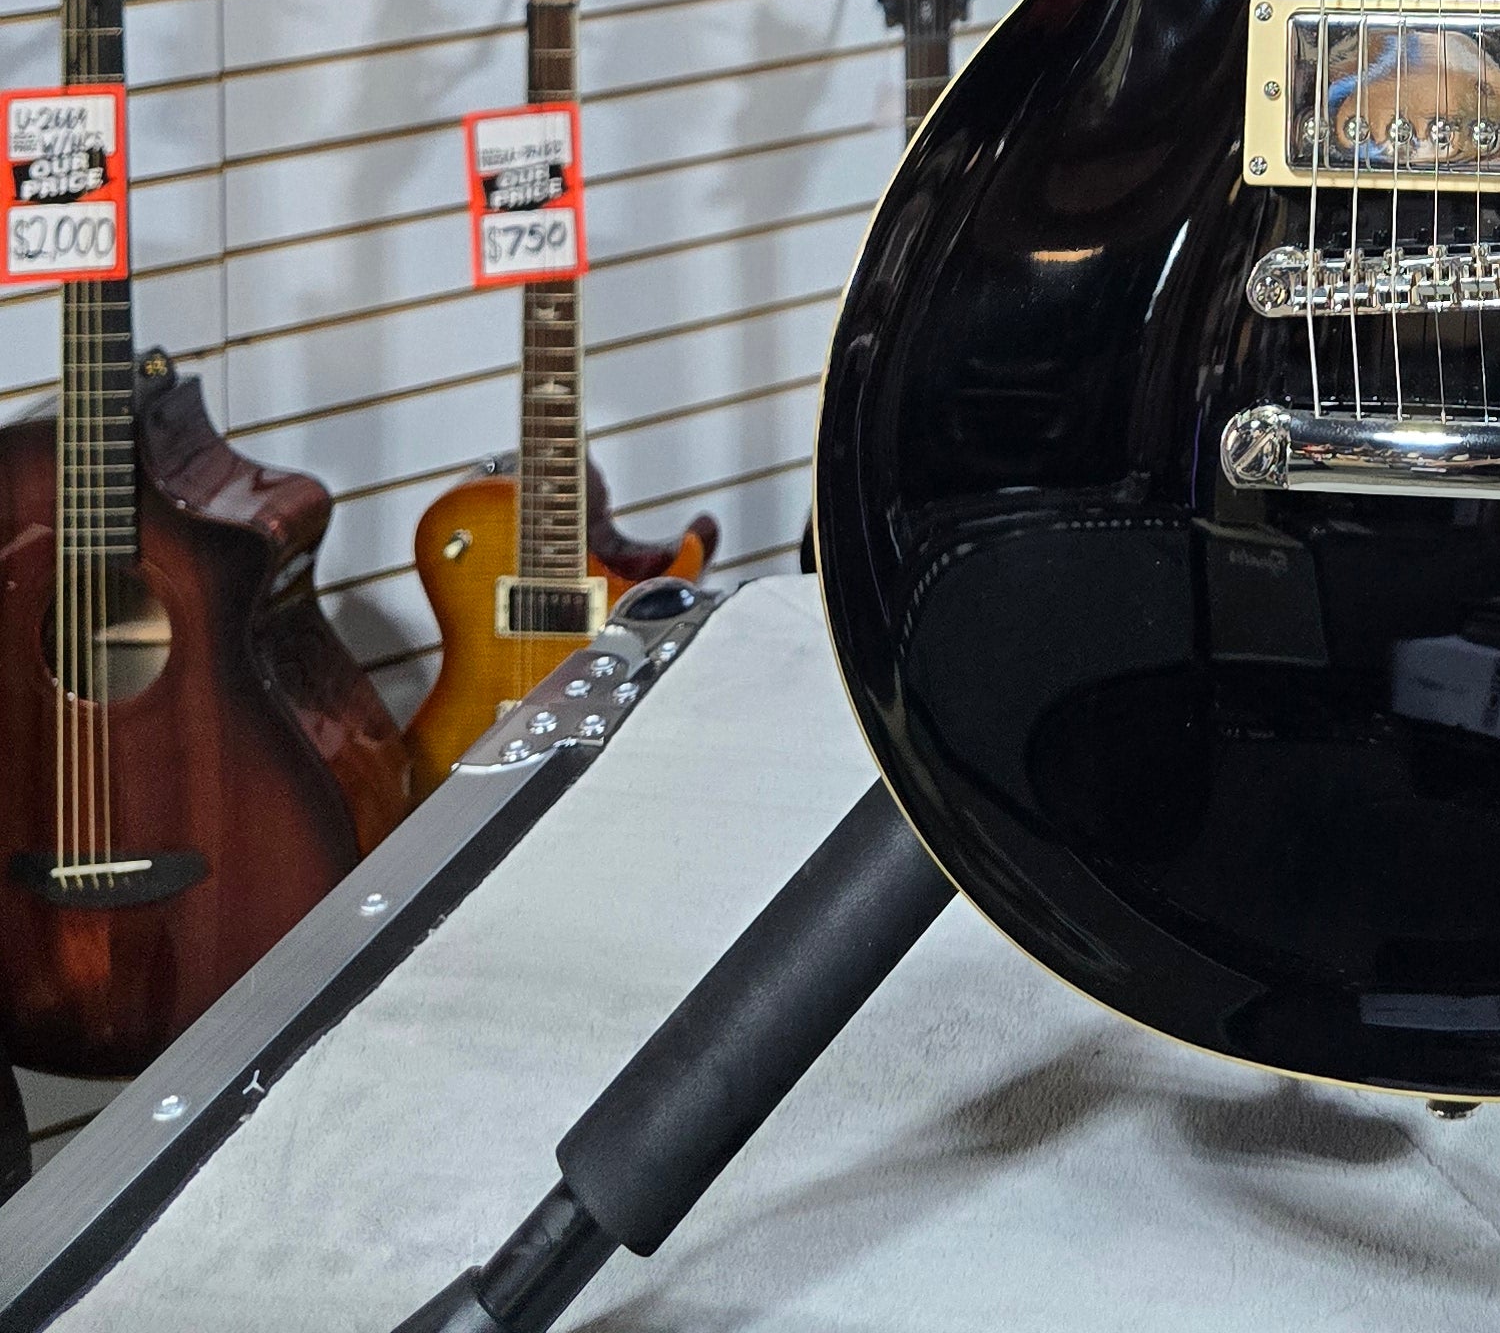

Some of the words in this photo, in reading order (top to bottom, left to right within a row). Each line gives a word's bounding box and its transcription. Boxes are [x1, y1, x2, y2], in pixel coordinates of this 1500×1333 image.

[20, 167, 104, 202] PRICE
[28, 152, 90, 180] OUR
[13, 215, 116, 262] $2,000
[488, 219, 568, 263] $750
